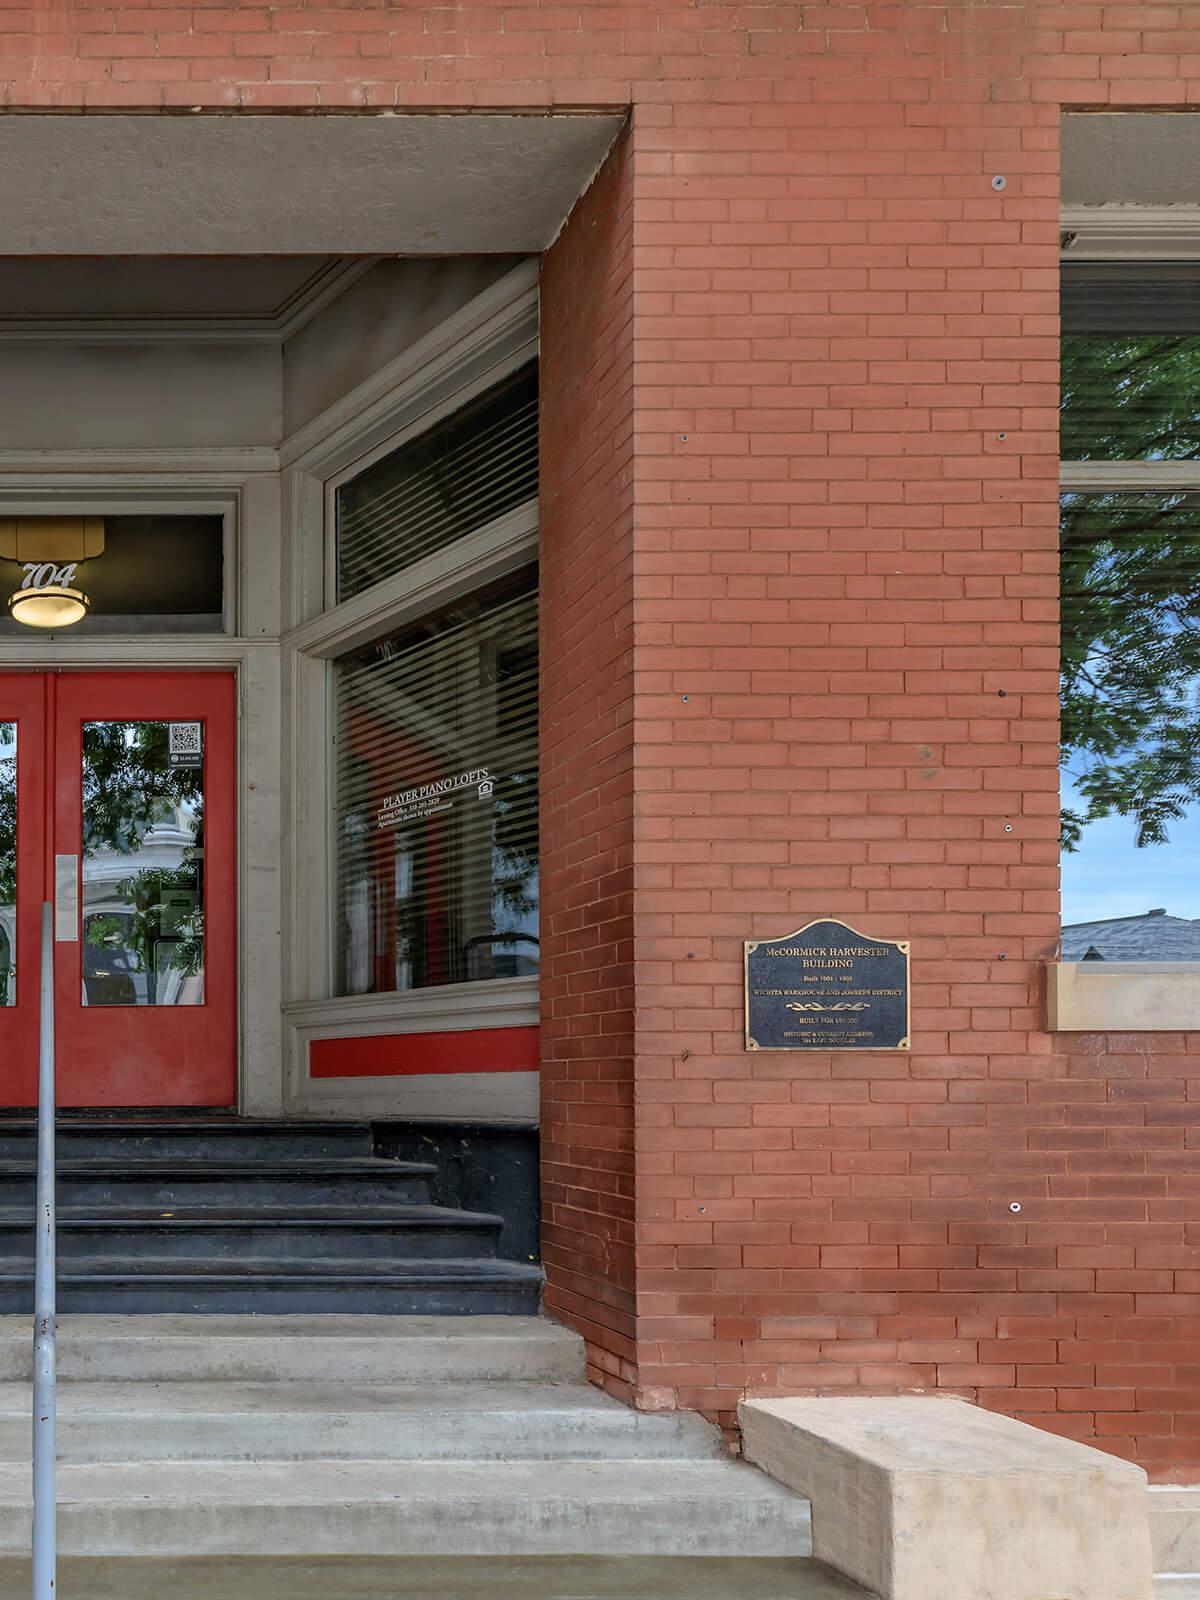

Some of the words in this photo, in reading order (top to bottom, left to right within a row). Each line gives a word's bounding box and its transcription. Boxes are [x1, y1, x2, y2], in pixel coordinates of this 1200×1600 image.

[21, 562, 78, 590] 704
[383, 788, 418, 809] PLAYER
[419, 778, 452, 797] PIANO
[454, 767, 489, 787] LOFTS
[765, 947, 827, 956] McCORMICK
[829, 947, 889, 956] HARVESTER
[802, 959, 854, 968] BUILDING
